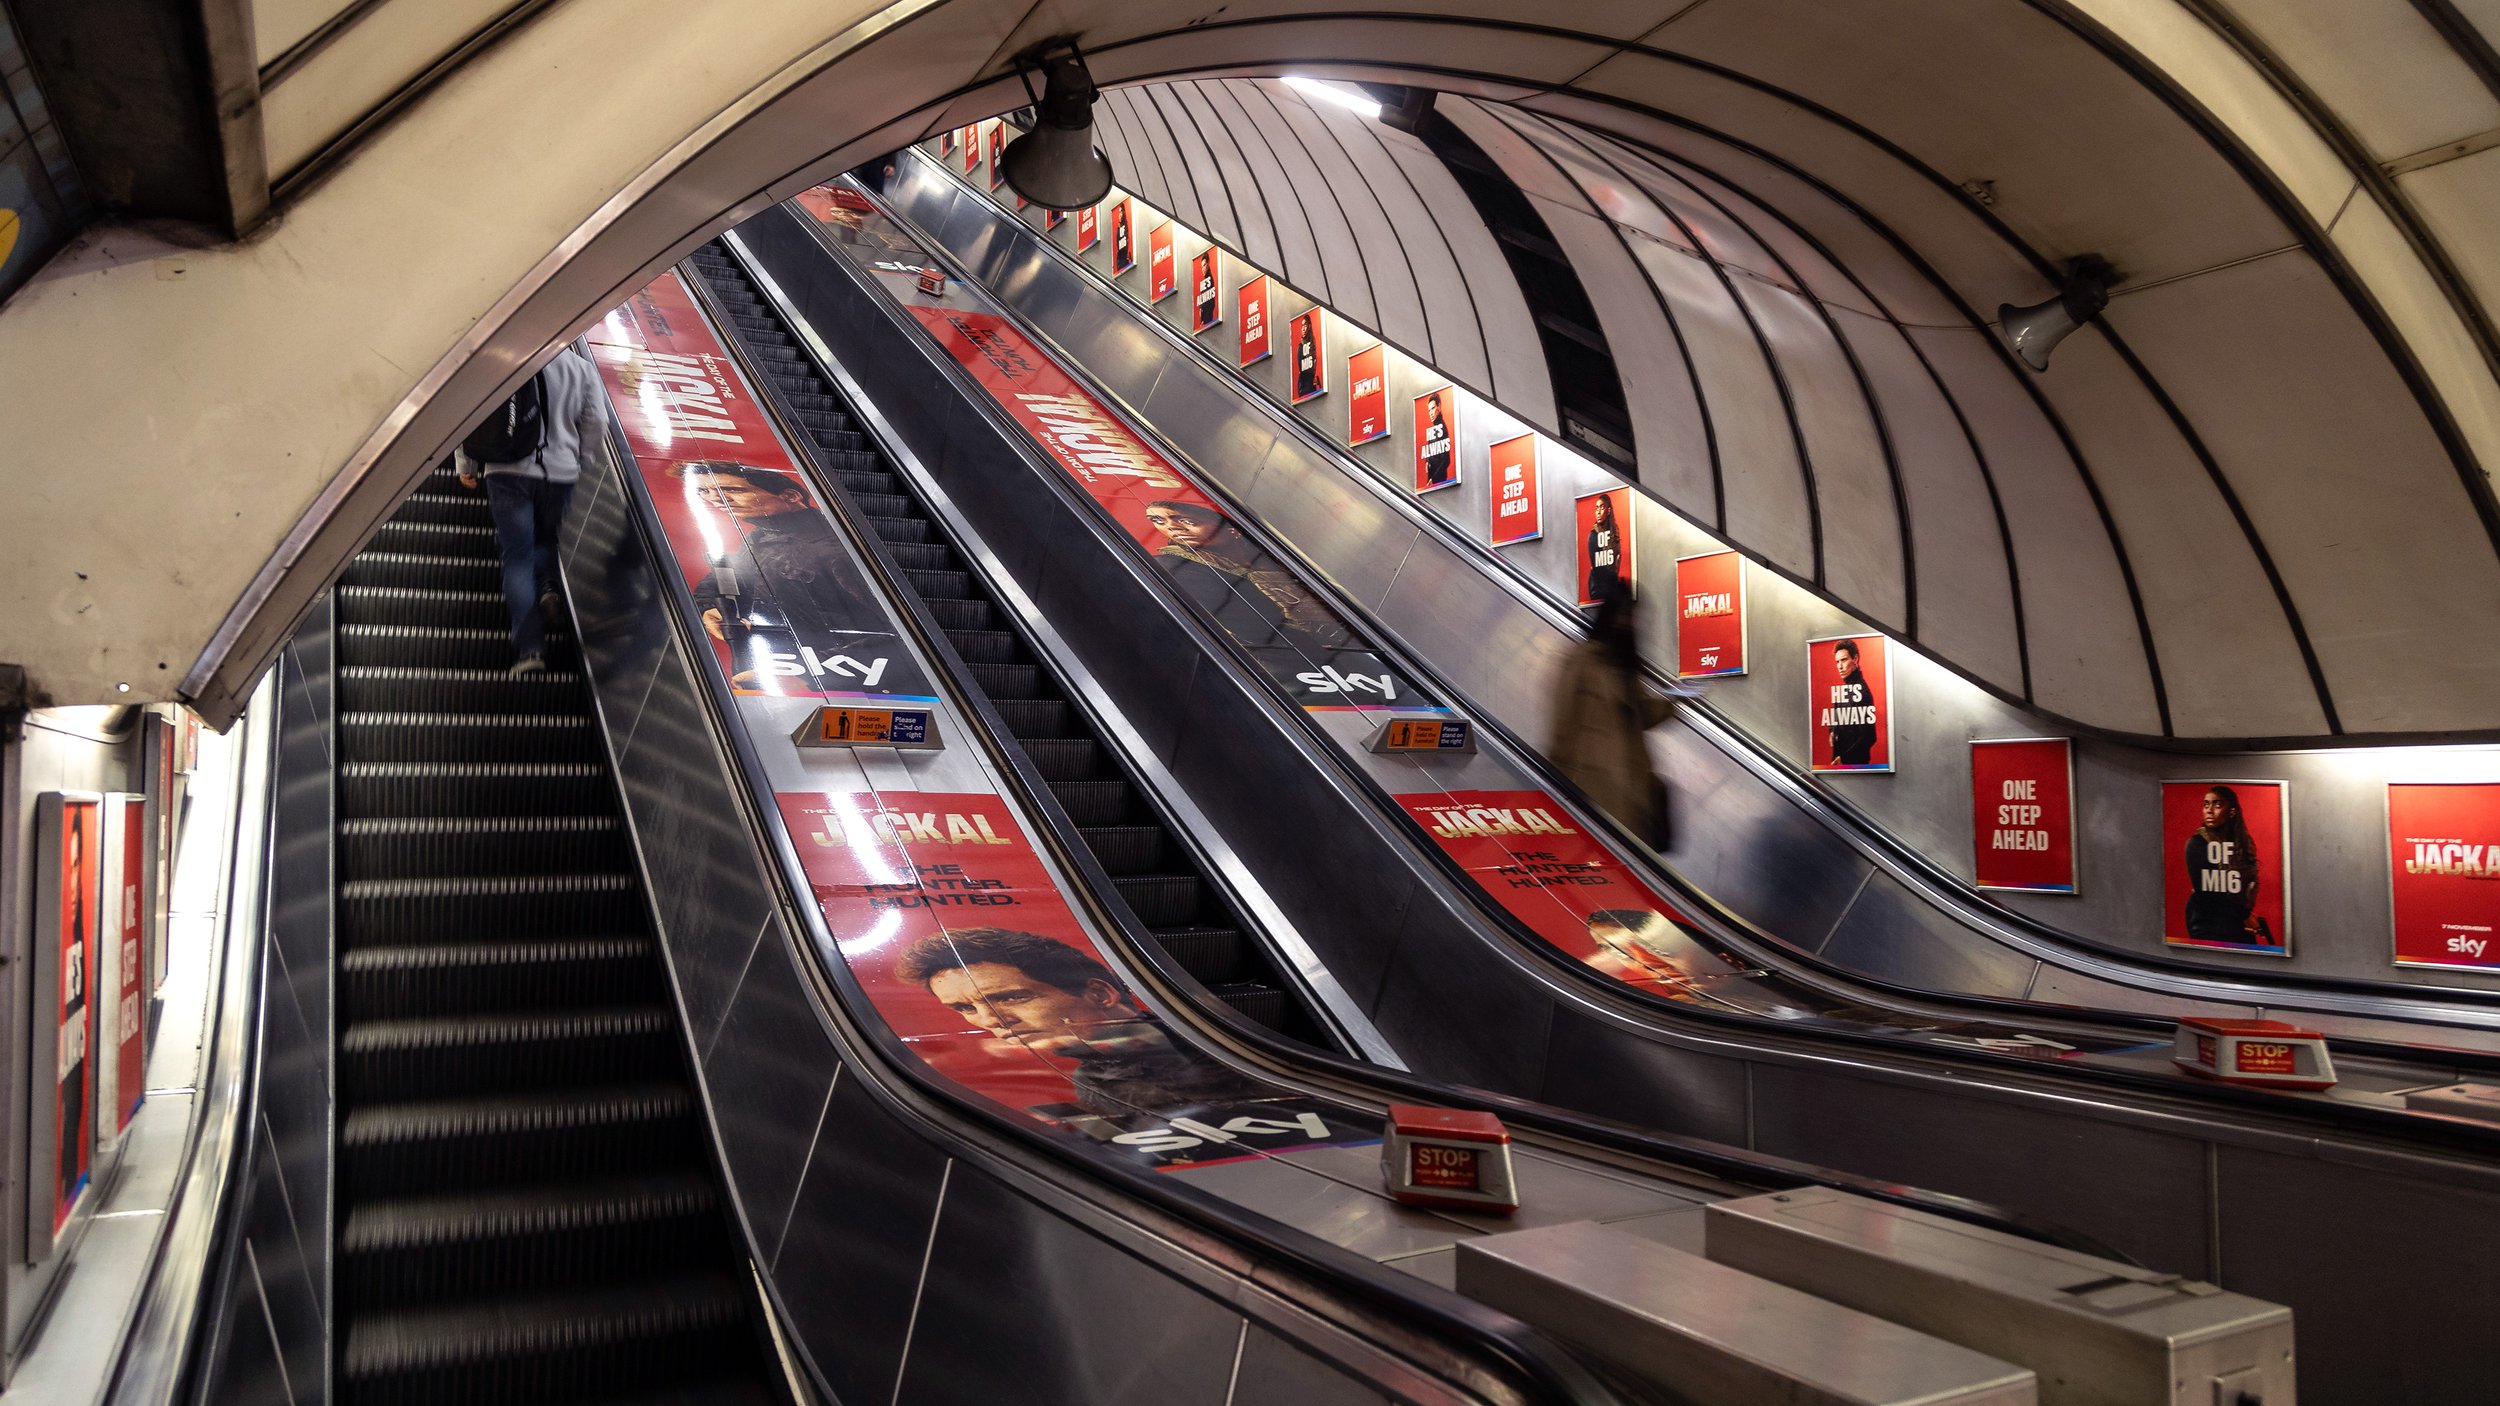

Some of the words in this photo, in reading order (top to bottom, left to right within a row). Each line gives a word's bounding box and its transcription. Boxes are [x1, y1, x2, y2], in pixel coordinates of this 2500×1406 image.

[1247, 312, 1261, 330] STEP
[1302, 341, 1311, 357] OF
[1014, 392, 1183, 489] JACKAL
[1425, 423, 1444, 442] HE'S
[1052, 444, 1069, 455] OF
[1421, 437, 1451, 460] ALWAYS
[1504, 463, 1523, 482] ONE
[1502, 480, 1525, 500] STEP
[1500, 497, 1529, 518] AHEAD
[1597, 530, 1611, 548] OF
[1594, 548, 1614, 568] MI6
[1683, 592, 1734, 619] JACKAL
[764, 646, 889, 686] sky
[1700, 653, 1719, 668] sky
[1296, 665, 1397, 700] sky
[1830, 683, 1863, 704] HE'S
[894, 716, 917, 724] Please
[1820, 705, 1877, 727] ALWAYS
[2002, 779, 2037, 801] ONE
[1431, 807, 1578, 838] JACKAL
[1998, 804, 2042, 826] STEP
[1992, 829, 2049, 851] AHEAD
[1507, 851, 1560, 862] THE
[2206, 841, 2235, 864] OF
[896, 863, 963, 877] THE
[1507, 875, 1615, 889] HUNTED.
[2201, 868, 2242, 894] MI6
[869, 894, 1022, 909] HUNTED.
[2447, 934, 2488, 958] sky
[2242, 1043, 2289, 1058] STOP
[1111, 1112, 1331, 1153] sky
[1419, 1148, 1471, 1166] STOP
